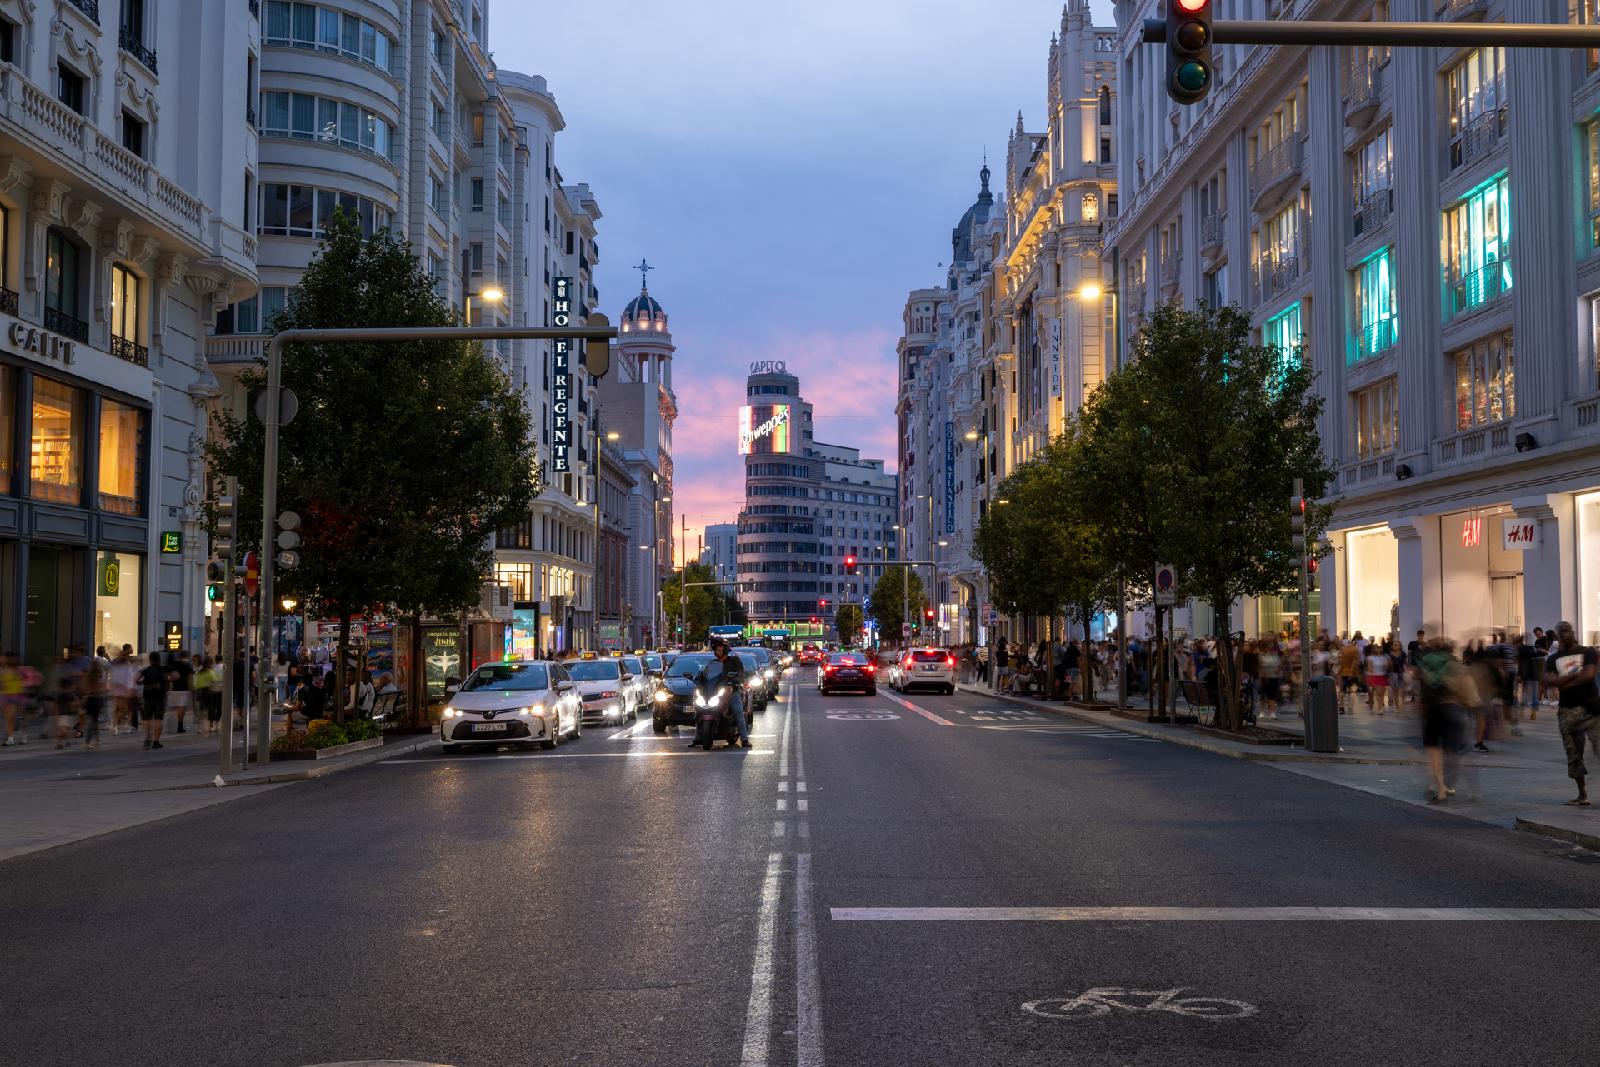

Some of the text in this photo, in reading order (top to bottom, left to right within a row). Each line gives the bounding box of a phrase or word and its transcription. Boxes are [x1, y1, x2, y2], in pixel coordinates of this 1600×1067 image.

[750, 361, 786, 373] CAPITOL
[554, 301, 569, 470] HOEL REGENTE
[1508, 525, 1534, 543] H&M
